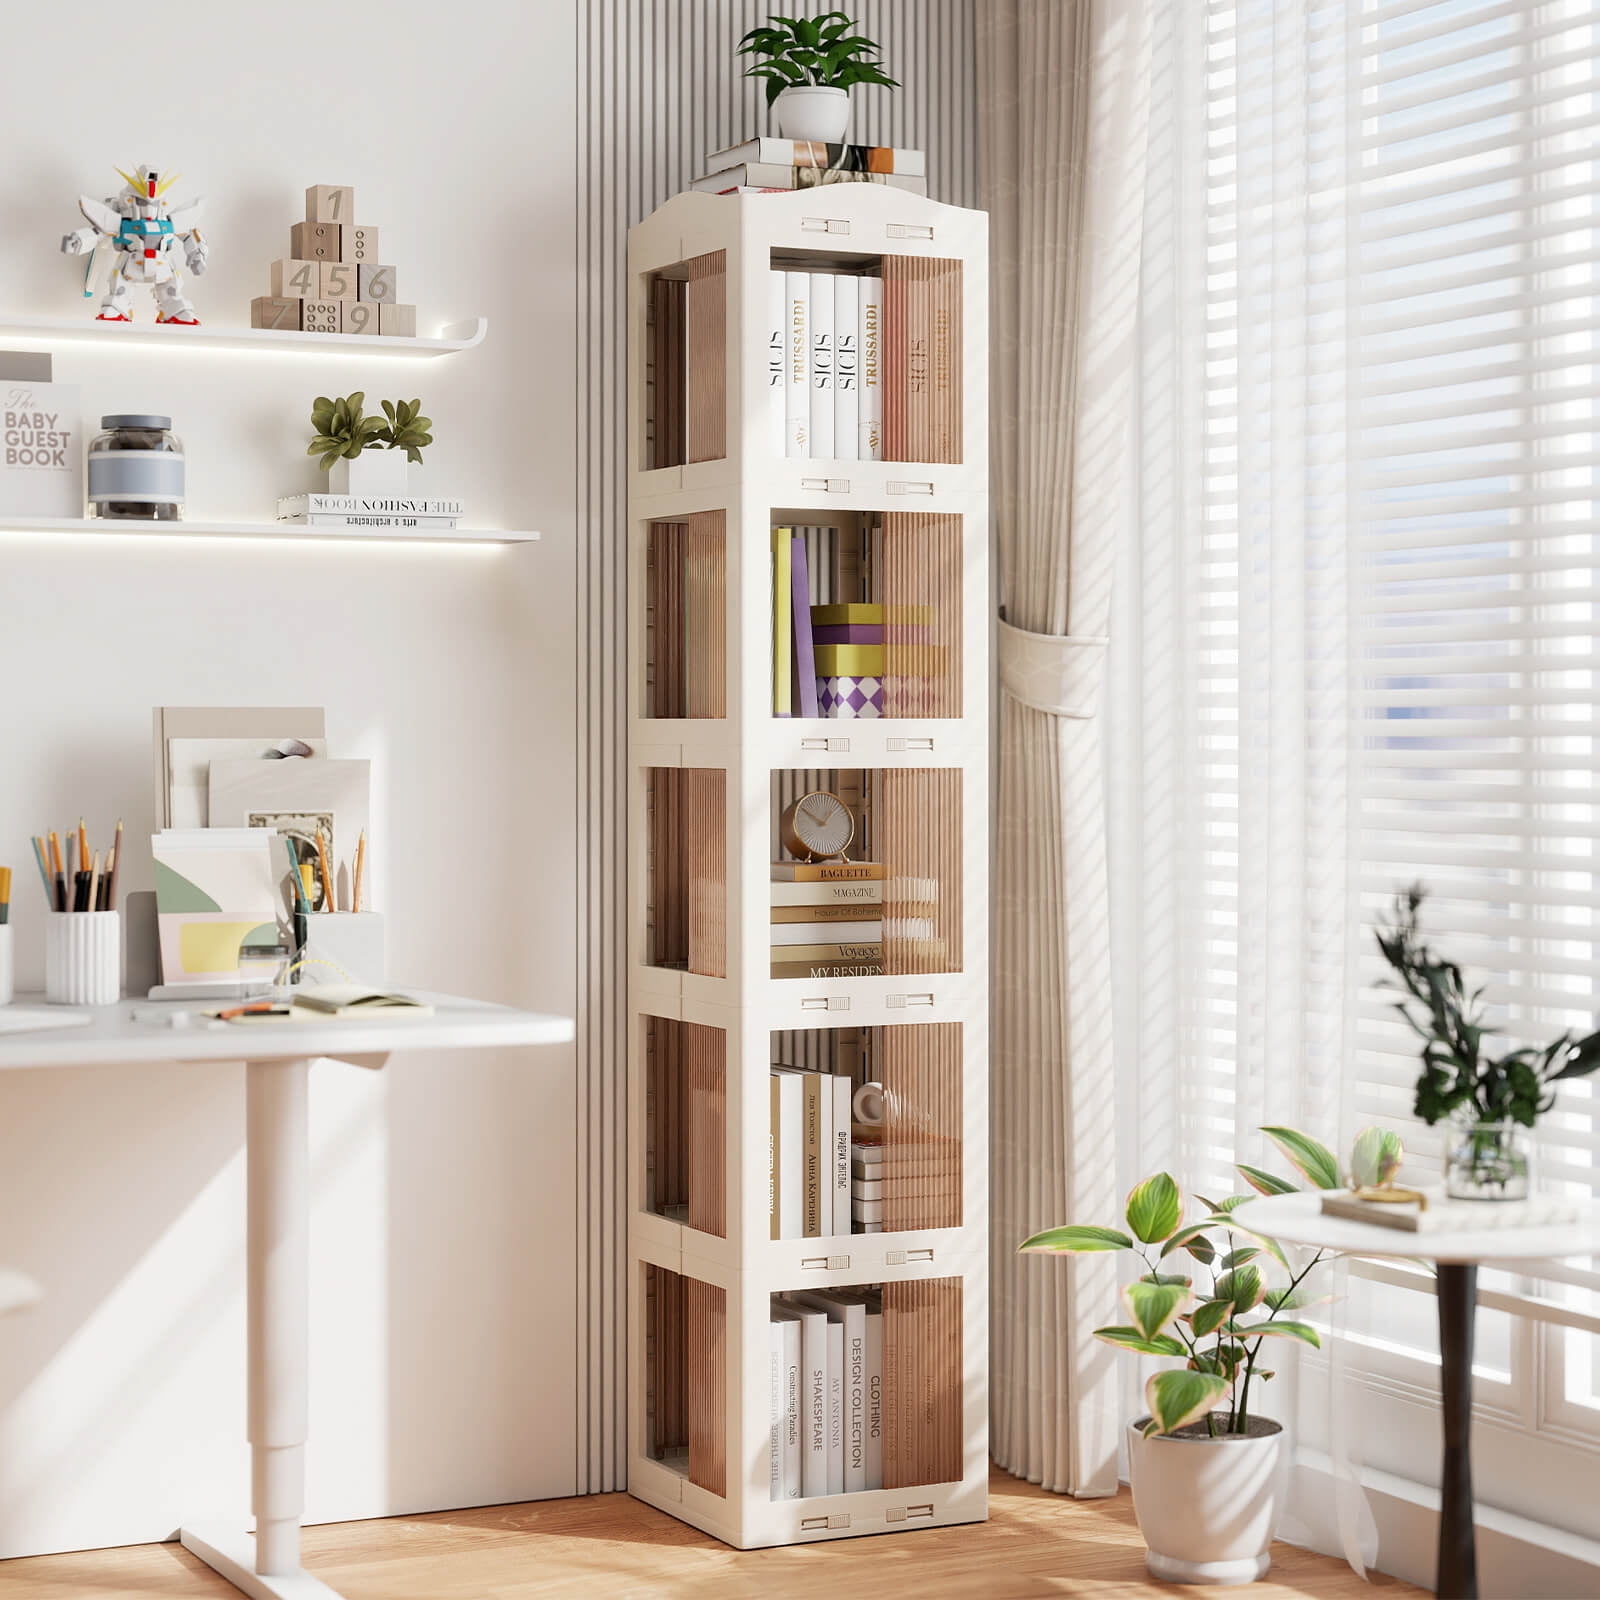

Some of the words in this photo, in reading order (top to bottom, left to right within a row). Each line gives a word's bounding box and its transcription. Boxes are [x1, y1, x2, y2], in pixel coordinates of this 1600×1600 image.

[327, 190, 343, 220] 1
[289, 264, 312, 295] 4
[327, 266, 350, 296] 5
[368, 269, 389, 299] 6
[272, 301, 293, 328] 7
[350, 306, 370, 334] 9
[793, 299, 806, 384] TRUSSARDI
[866, 304, 878, 387] TRUSSARDI
[770, 331, 783, 387] SICIS
[814, 333, 832, 390] SICIS
[838, 335, 856, 391] SICIS
[5, 411, 58, 430] BABY
[5, 430, 71, 449] GUEST
[6, 448, 65, 466] BOOK
[313, 497, 357, 511] BOOK
[362, 498, 427, 513] FASHION
[431, 500, 463, 513] THE
[346, 516, 391, 527] architecture
[820, 868, 872, 879] BAGUETTE
[833, 887, 876, 898] MAGAZINE
[838, 945, 880, 960] Voyage
[810, 967, 830, 978] MY
[852, 1338, 862, 1385] DESIGN
[788, 1365, 798, 1413] Constructing
[831, 1377, 840, 1394] MY
[813, 1370, 823, 1451] SHAKESPEARE
[870, 1375, 880, 1438] CLOTHING
[831, 1398, 840, 1448] ANTONIA
[852, 1388, 862, 1468] COLLECTION
